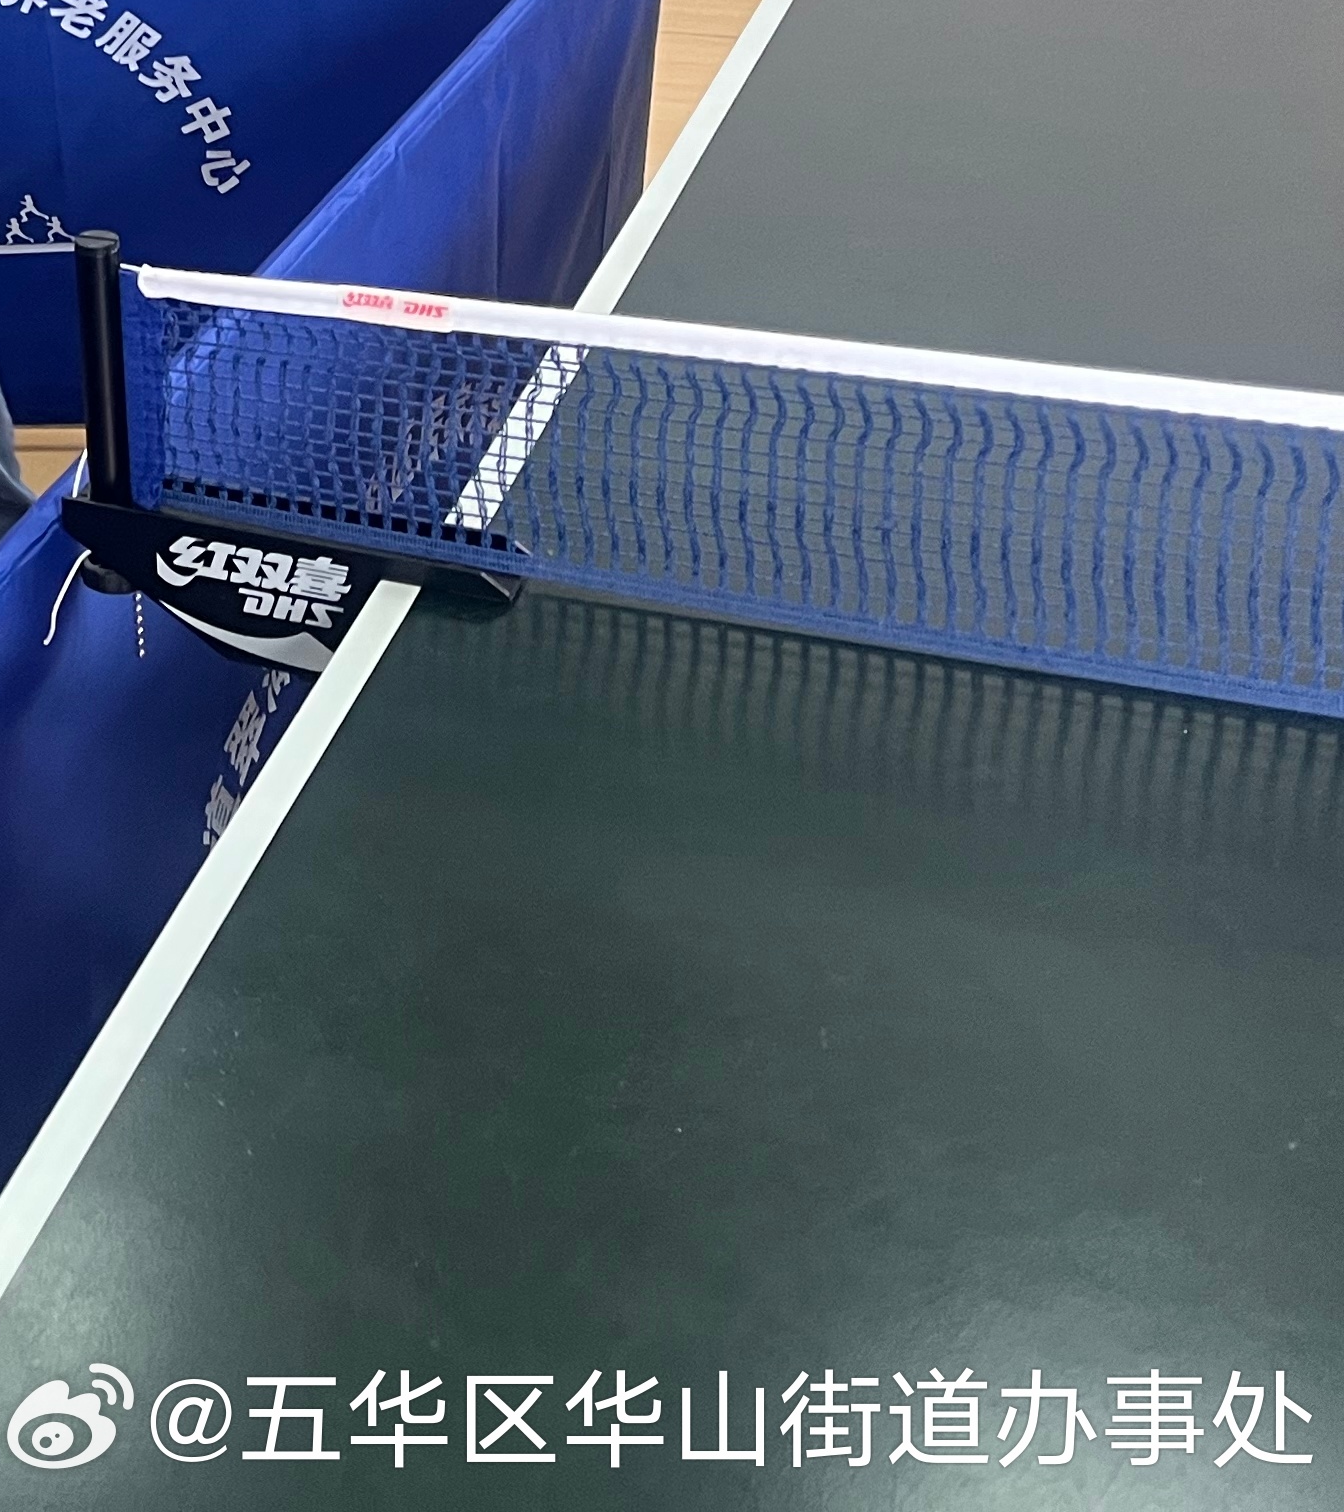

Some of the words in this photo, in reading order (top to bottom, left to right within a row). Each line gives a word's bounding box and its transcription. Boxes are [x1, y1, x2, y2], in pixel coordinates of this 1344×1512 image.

[156, 535, 353, 603] 红双喜
[238, 587, 345, 630] DHS
